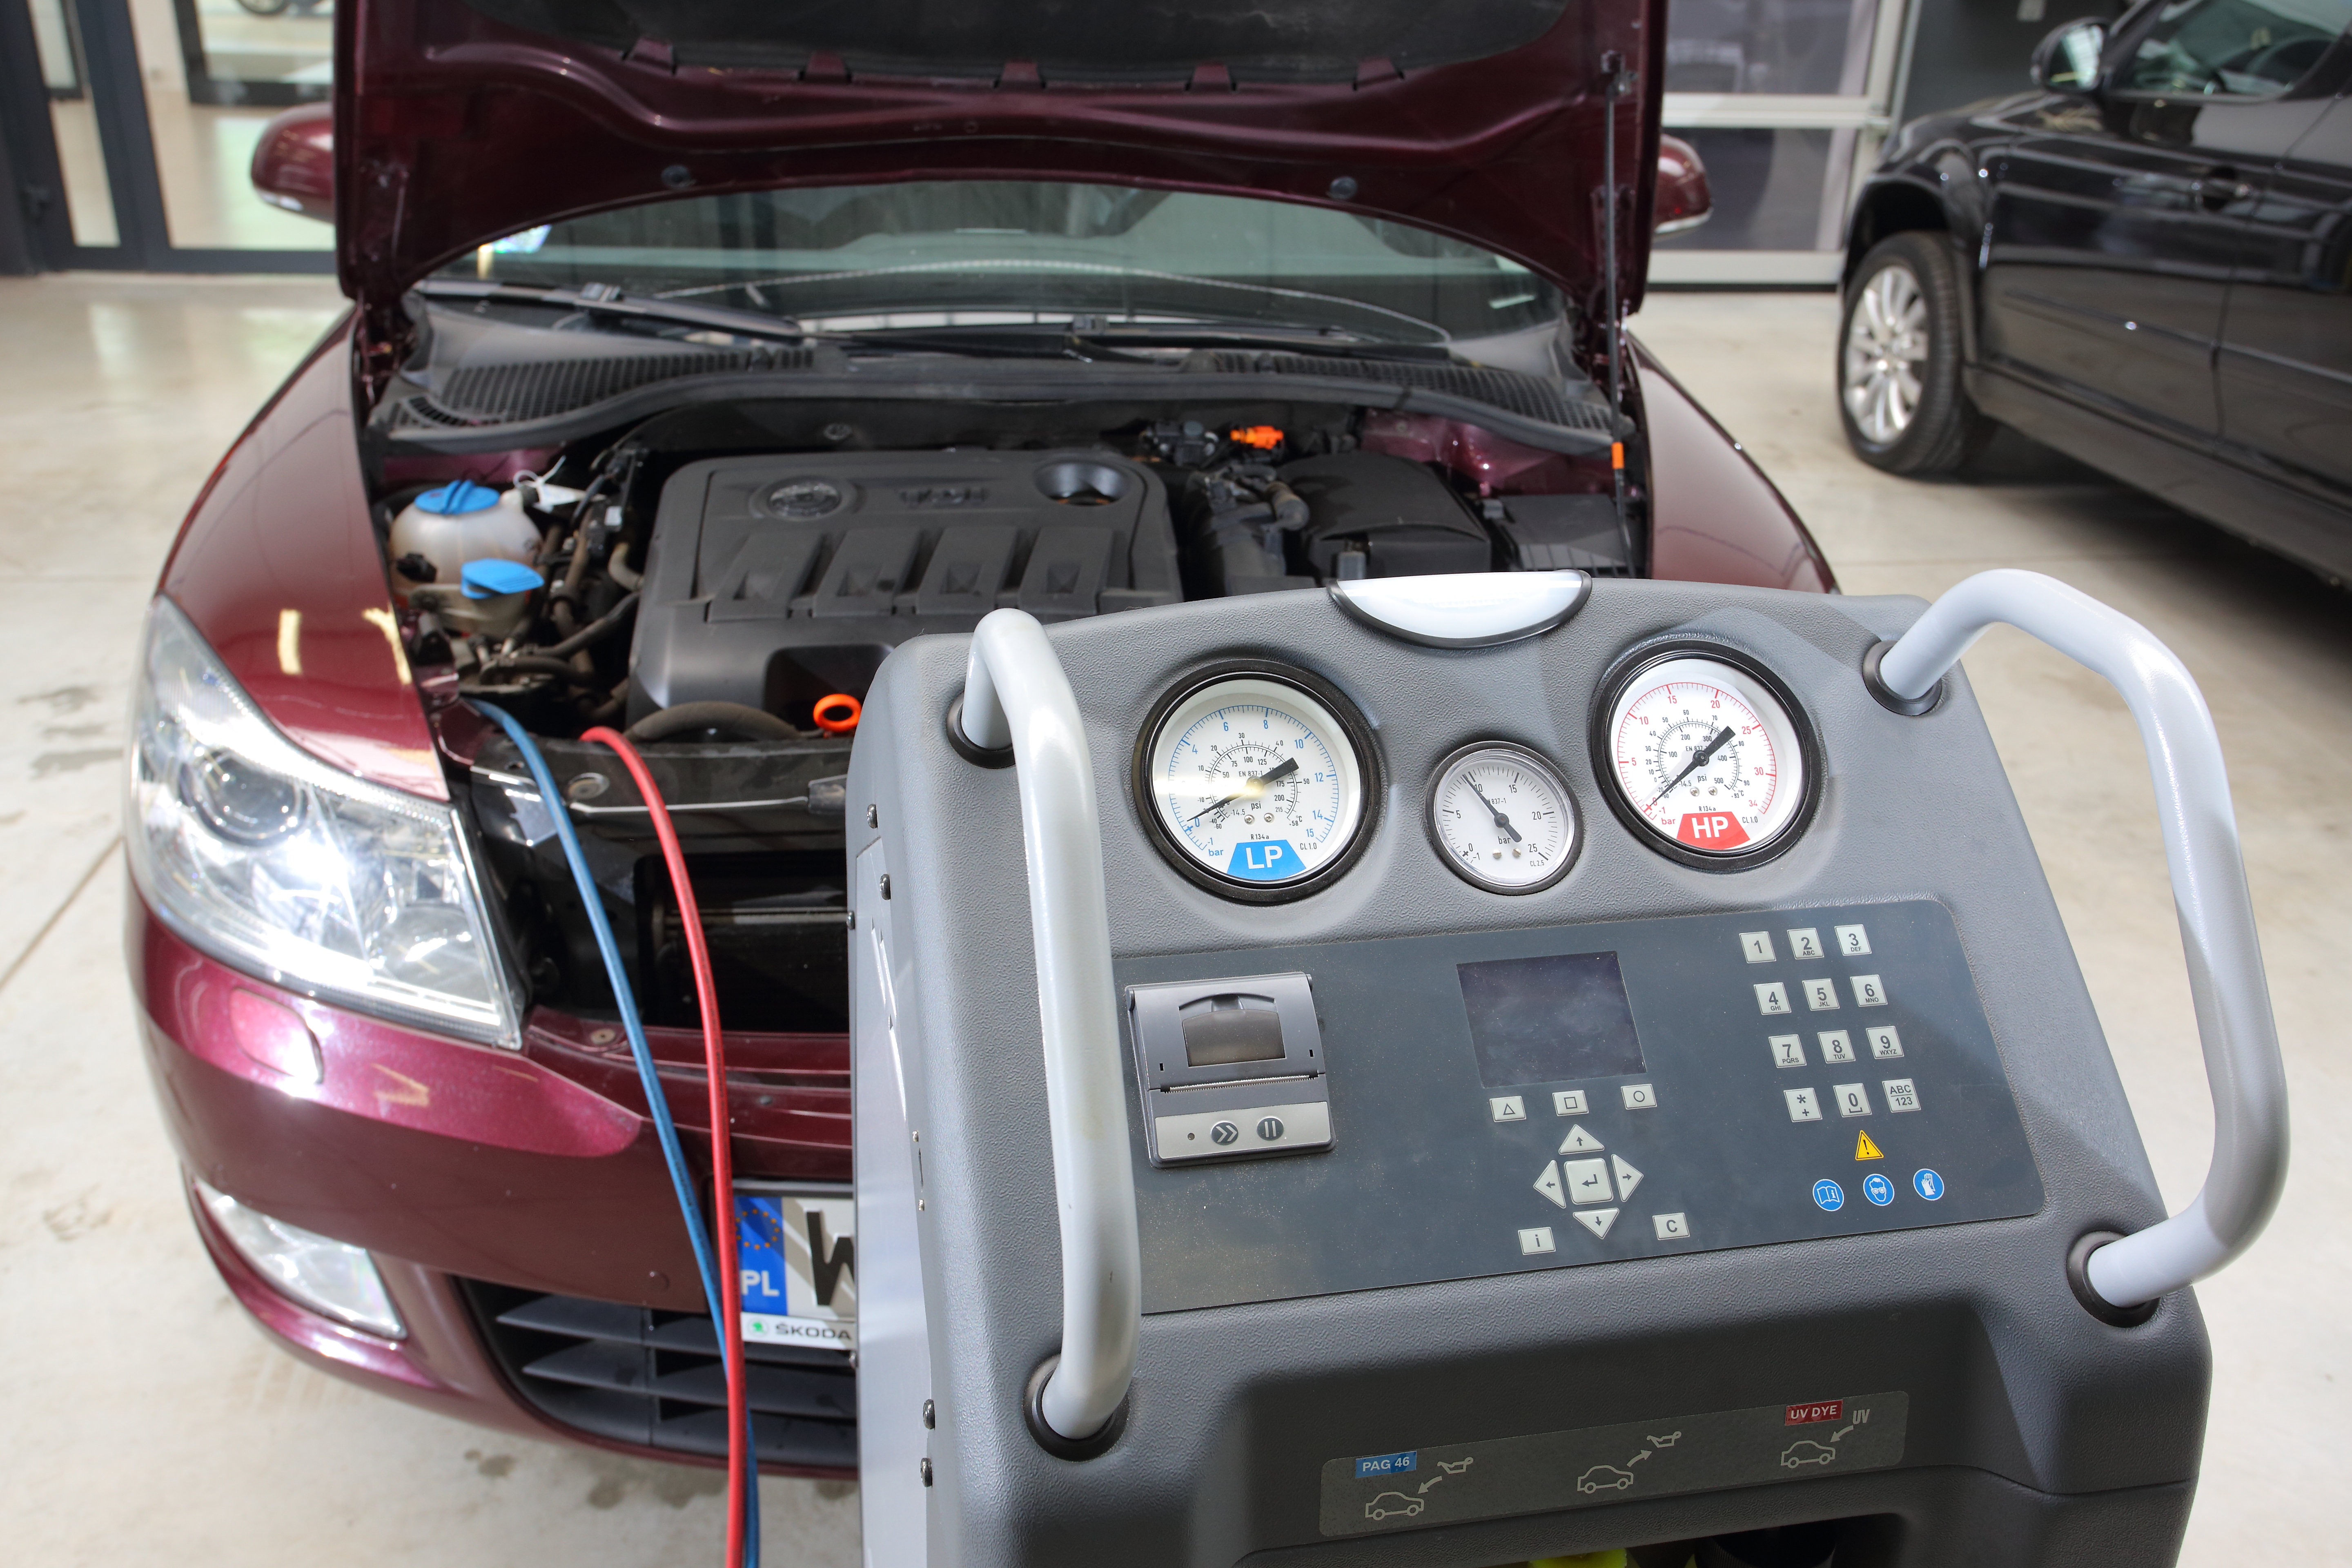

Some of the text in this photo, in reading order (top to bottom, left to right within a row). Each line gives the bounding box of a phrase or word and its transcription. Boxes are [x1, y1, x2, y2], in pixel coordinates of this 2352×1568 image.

[1668, 695, 1677, 704] 15
[1264, 720, 1268, 729] 8
[1639, 716, 1648, 725] 10
[1224, 722, 1228, 731] 6
[1742, 726, 1751, 734] 25
[1294, 739, 1303, 748] 10
[1192, 744, 1198, 754] 4
[1632, 757, 1636, 766] 5
[1754, 767, 1764, 775] 30
[1315, 773, 1323, 782] 12
[1697, 774, 1707, 783] psi
[1474, 784, 1483, 792] 10
[1509, 784, 1517, 793] 15
[1251, 801, 1261, 810] psi
[1312, 810, 1323, 820] 14
[1456, 810, 1461, 819] 5
[1532, 811, 1541, 820] 20
[1194, 817, 1200, 827] 0
[1692, 816, 1728, 838] HP
[1306, 829, 1314, 837] 15
[1498, 836, 1510, 844] bar
[1468, 843, 1473, 851] 0
[1528, 844, 1537, 853] 25
[1246, 845, 1283, 869] LP
[1801, 937, 1812, 950] 2
[1849, 933, 1859, 946] 3
[1754, 940, 1762, 953] 1
[1817, 987, 1827, 1001] 5
[1865, 984, 1875, 997] 6
[1768, 991, 1779, 1005] 4
[1832, 1040, 1842, 1054] 8
[1880, 1035, 1891, 1049] 9
[1782, 1044, 1791, 1058] 7
[1890, 1085, 1911, 1094] ABC
[1849, 1093, 1858, 1107] 0
[1895, 1097, 1912, 1107] 123
[1666, 1220, 1678, 1233] C
[1535, 1234, 1541, 1247] i
[740, 1270, 780, 1297] PL
[776, 1322, 852, 1340] ŠKODA
[1791, 1405, 1838, 1420] UV DYE
[1852, 1409, 1870, 1425] UV
[1362, 1456, 1410, 1472] PAG 46
